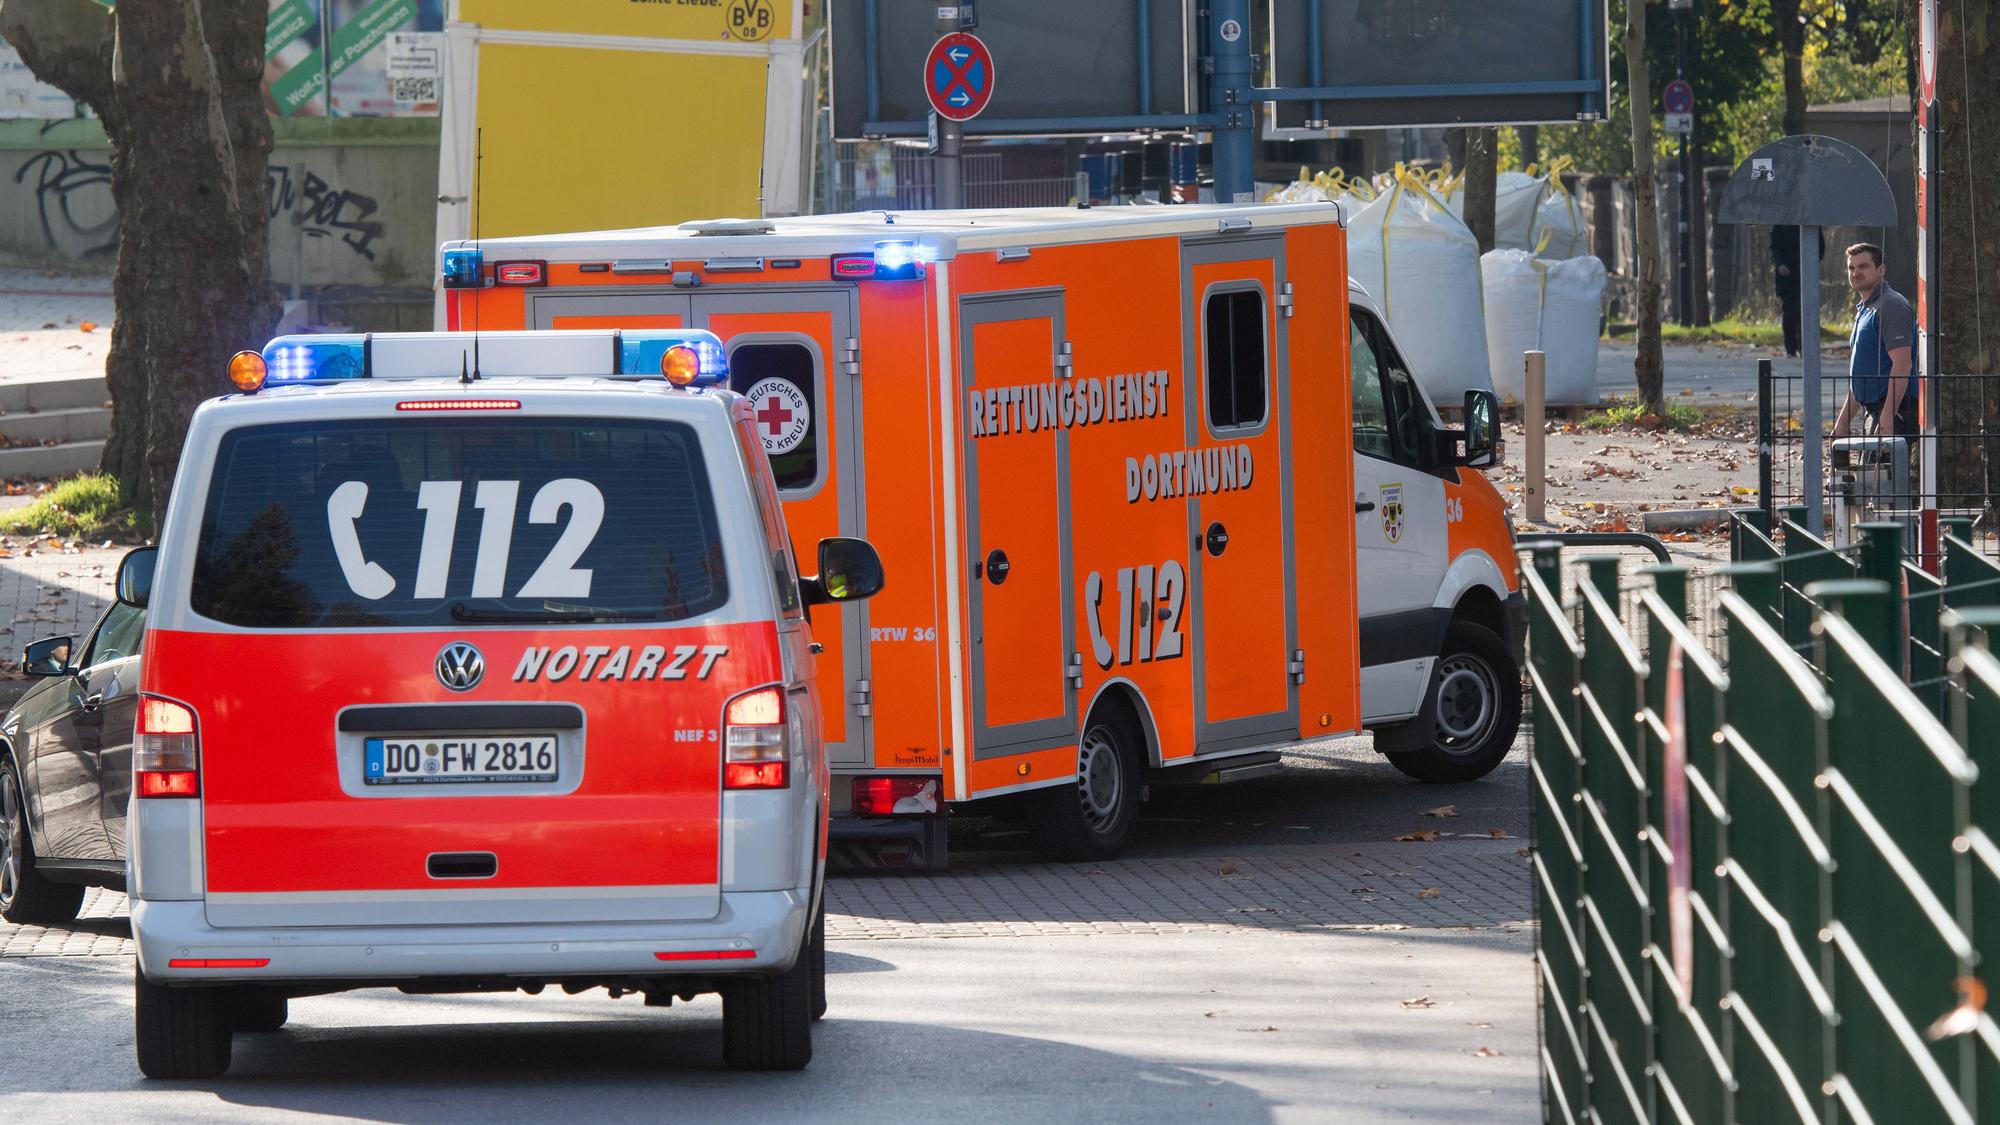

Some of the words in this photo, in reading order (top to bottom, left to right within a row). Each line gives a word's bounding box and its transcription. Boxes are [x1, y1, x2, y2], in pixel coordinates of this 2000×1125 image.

[733, 0, 769, 27] BVB
[344, 6, 409, 59] Poschmann
[743, 27, 757, 37] 09
[970, 370, 1169, 438] RETTUNGSDIENST
[777, 417, 806, 449] KREUZ
[1126, 444, 1253, 504] DORTMUND
[1447, 498, 1463, 523] 36
[413, 477, 605, 599] 112
[1117, 559, 1186, 666] 112
[871, 627, 907, 641] RTW
[913, 627, 936, 641] 36
[511, 645, 728, 682] NOTARZT
[674, 729, 704, 742] NEF
[708, 729, 718, 742] 3
[372, 762, 380, 772] D
[386, 744, 420, 773] DO
[442, 743, 477, 772] FW
[484, 742, 552, 771] 2816
